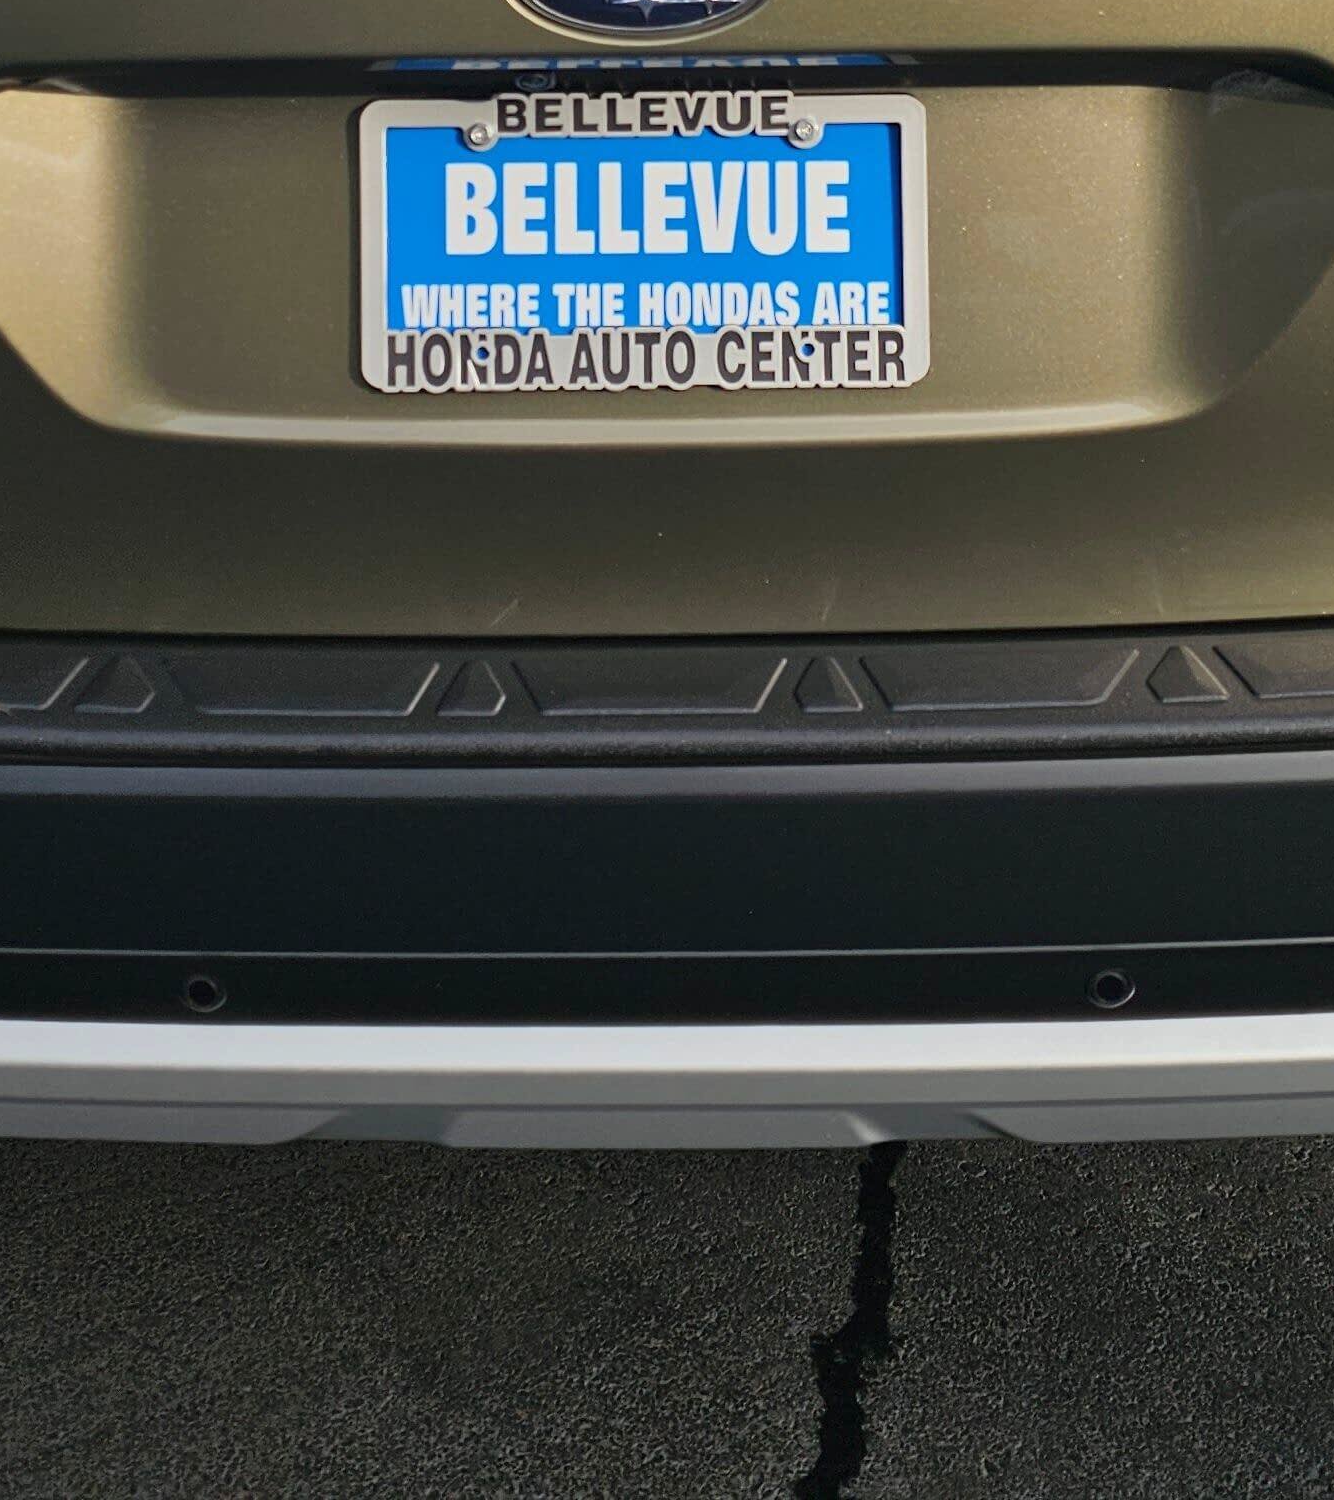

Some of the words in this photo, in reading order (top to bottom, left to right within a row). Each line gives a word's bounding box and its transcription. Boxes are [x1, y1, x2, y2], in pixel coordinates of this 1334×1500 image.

[496, 94, 792, 136] BELLEVUE
[444, 159, 851, 256] BELLEVUE
[400, 283, 541, 328] WHERE
[552, 282, 626, 327] THE
[637, 281, 800, 327] HONDAS
[812, 281, 891, 326] ARE
[386, 332, 555, 387] HONDA
[568, 330, 698, 385] AUTO
[716, 330, 906, 384] CENTER
